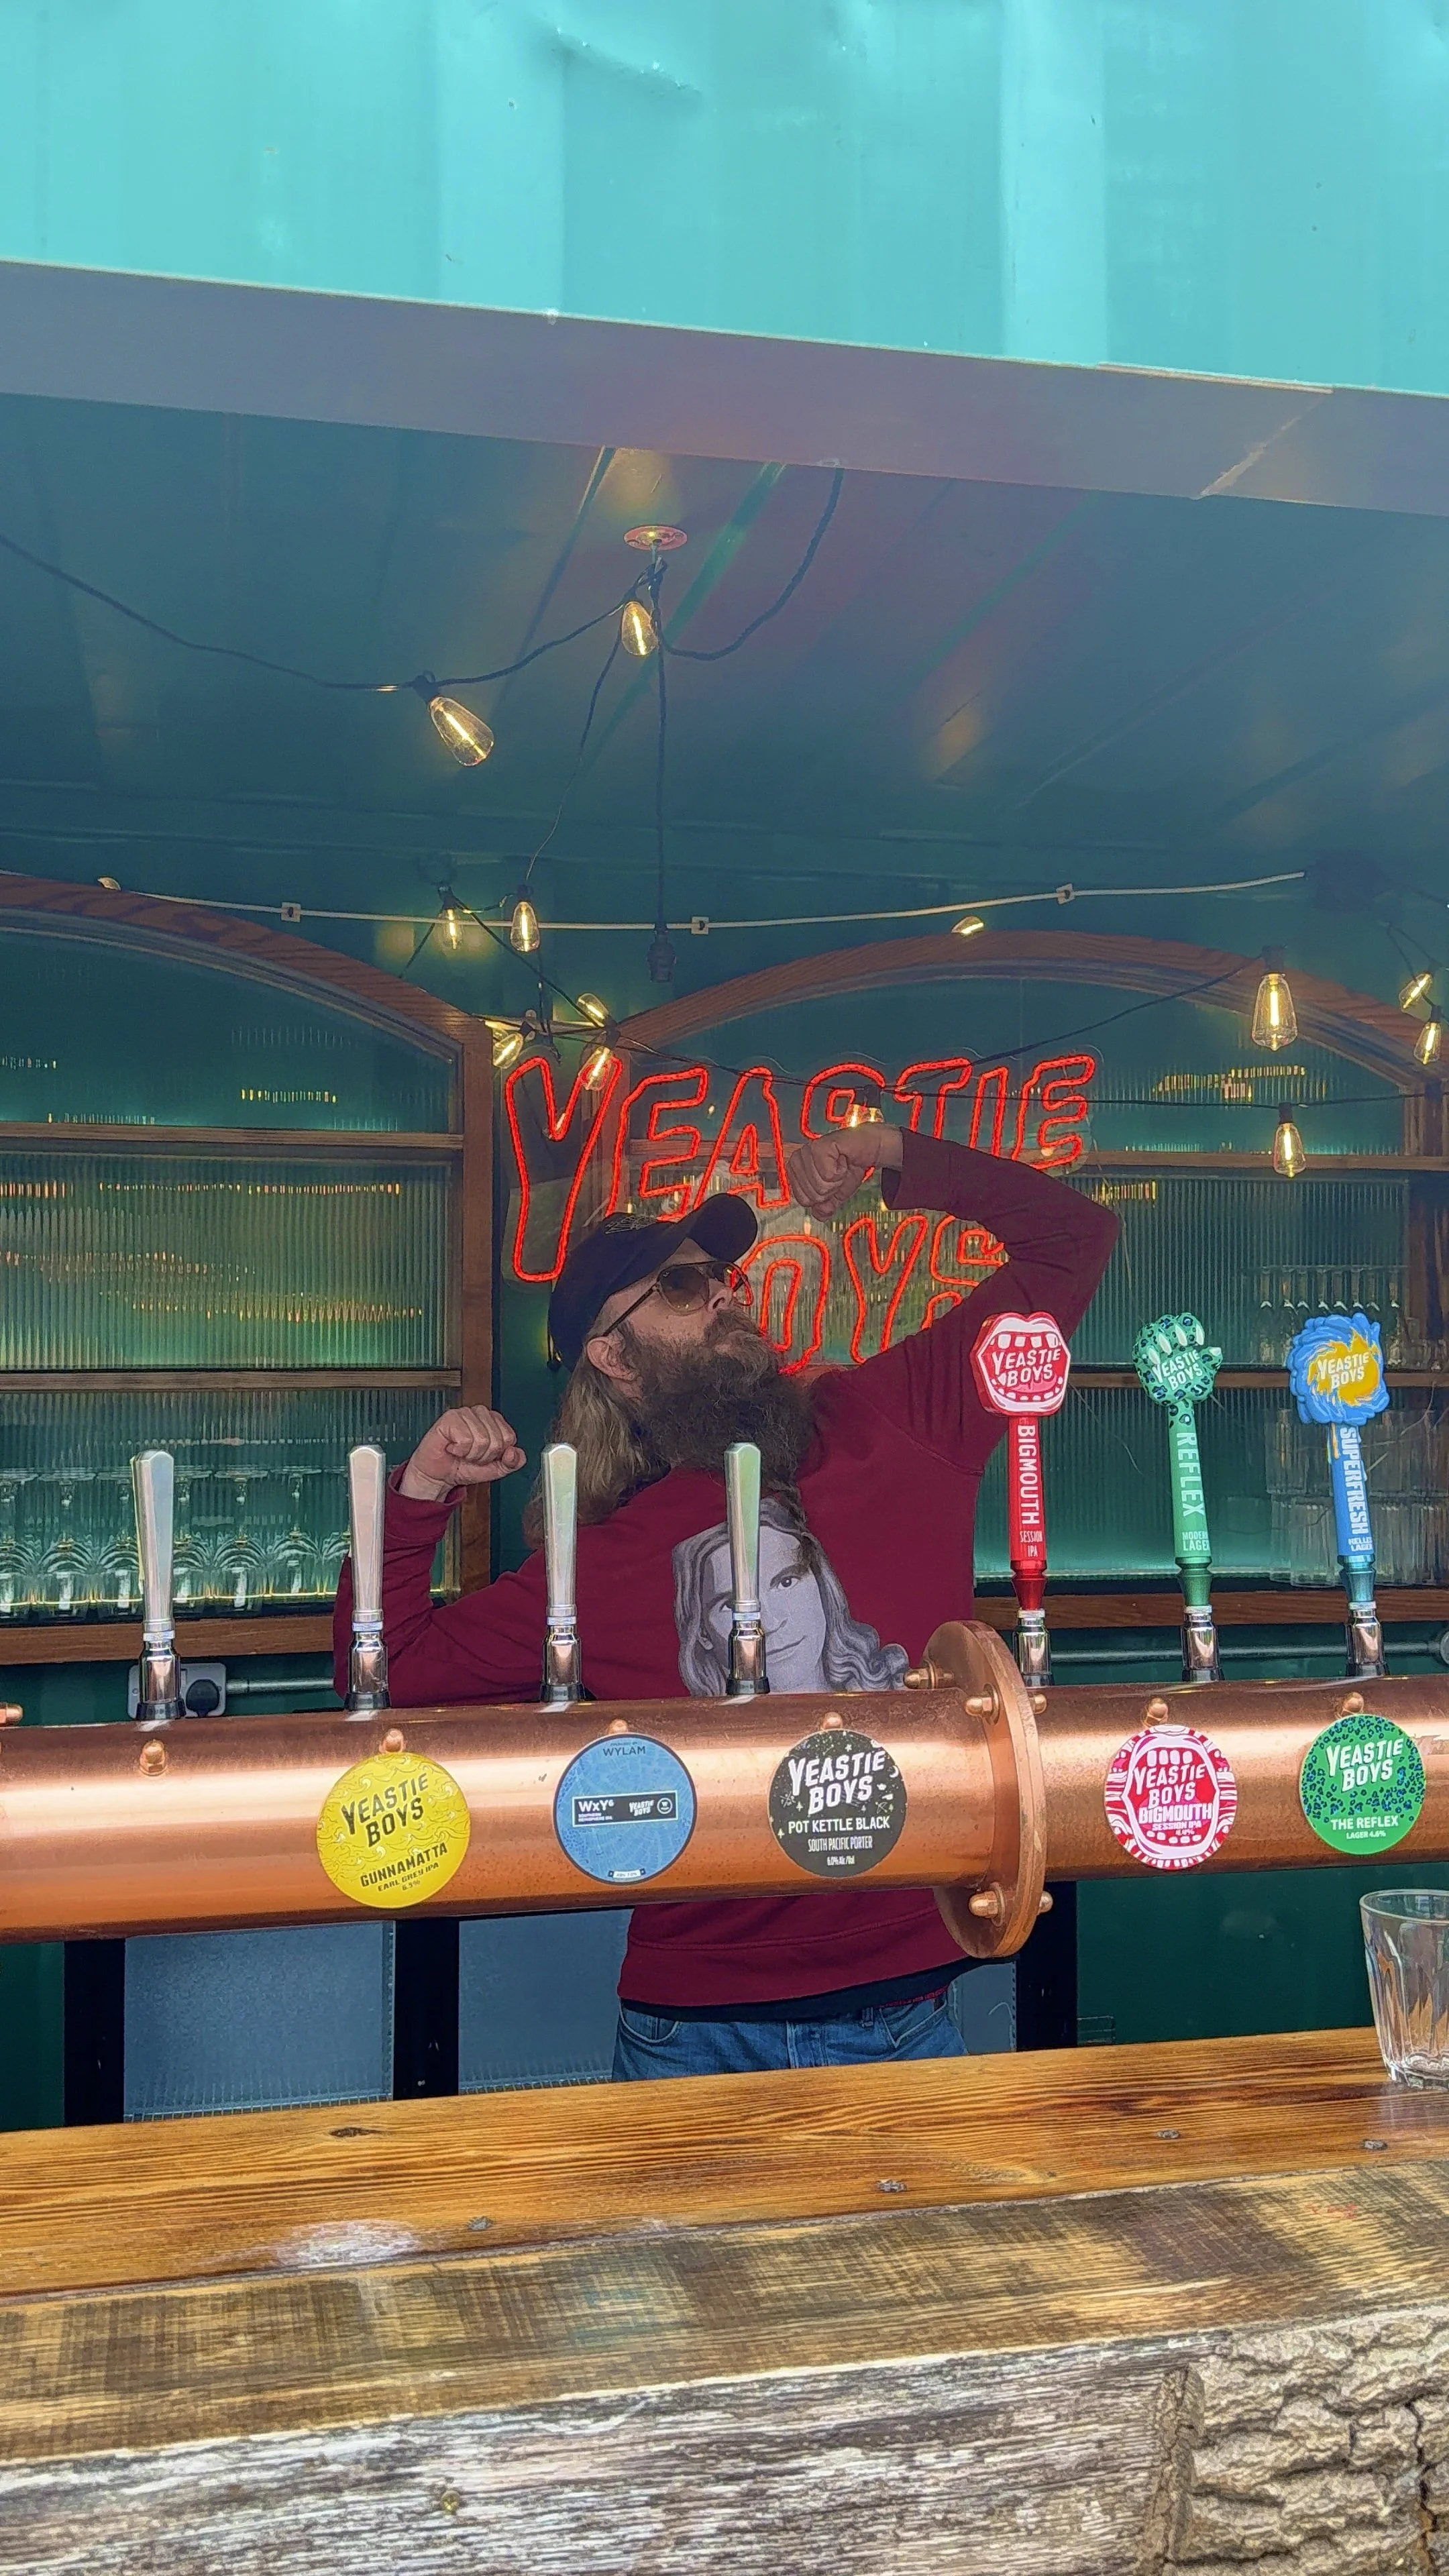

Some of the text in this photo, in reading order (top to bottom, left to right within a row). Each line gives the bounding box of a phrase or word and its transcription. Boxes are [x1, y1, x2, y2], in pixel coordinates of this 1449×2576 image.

[991, 1348, 1061, 1375] YEASTIE
[1007, 1364, 1053, 1387] BOYS
[1152, 1350, 1200, 1383] YEASTIE
[1318, 1352, 1370, 1380] YEASTIE
[1167, 1362, 1203, 1391] BOYS
[1331, 1366, 1365, 1389] BOYS
[1018, 1425, 1040, 1525] BIGMOUTH
[1177, 1432, 1205, 1517] REFLEX
[1340, 1427, 1369, 1535] SUPERFRESH
[1028, 1545, 1038, 1557] IPA
[1183, 1540, 1210, 1552] LAGER
[603, 1746, 645, 1756] WYLAM
[1326, 1738, 1404, 1777] YEASTIE
[788, 1750, 885, 1796] YEASTIE
[1133, 1763, 1206, 1795] YEASTIE
[1342, 1759, 1393, 1792] BOYS
[341, 1773, 429, 1835] YEASTIE
[808, 1775, 873, 1815] BOYS
[1148, 1782, 1195, 1810] BOYS
[366, 1797, 424, 1847] BOYS
[634, 1807, 651, 1816] BOYS
[788, 1816, 890, 1834] POT KETTLE BLACK
[1138, 1803, 1214, 1824] BIGMOUTH
[1330, 1815, 1399, 1830] THE REFLEX
[1152, 1821, 1187, 1831] SESSION
[1346, 1831, 1368, 1839] LAGER
[808, 1835, 873, 1852] SOUTH PACIFIC PORTER
[360, 1842, 447, 1887] GUNNAMATTA
[378, 1862, 439, 1891] EARL GREY IPA
[402, 1879, 421, 1891] 6.5%
